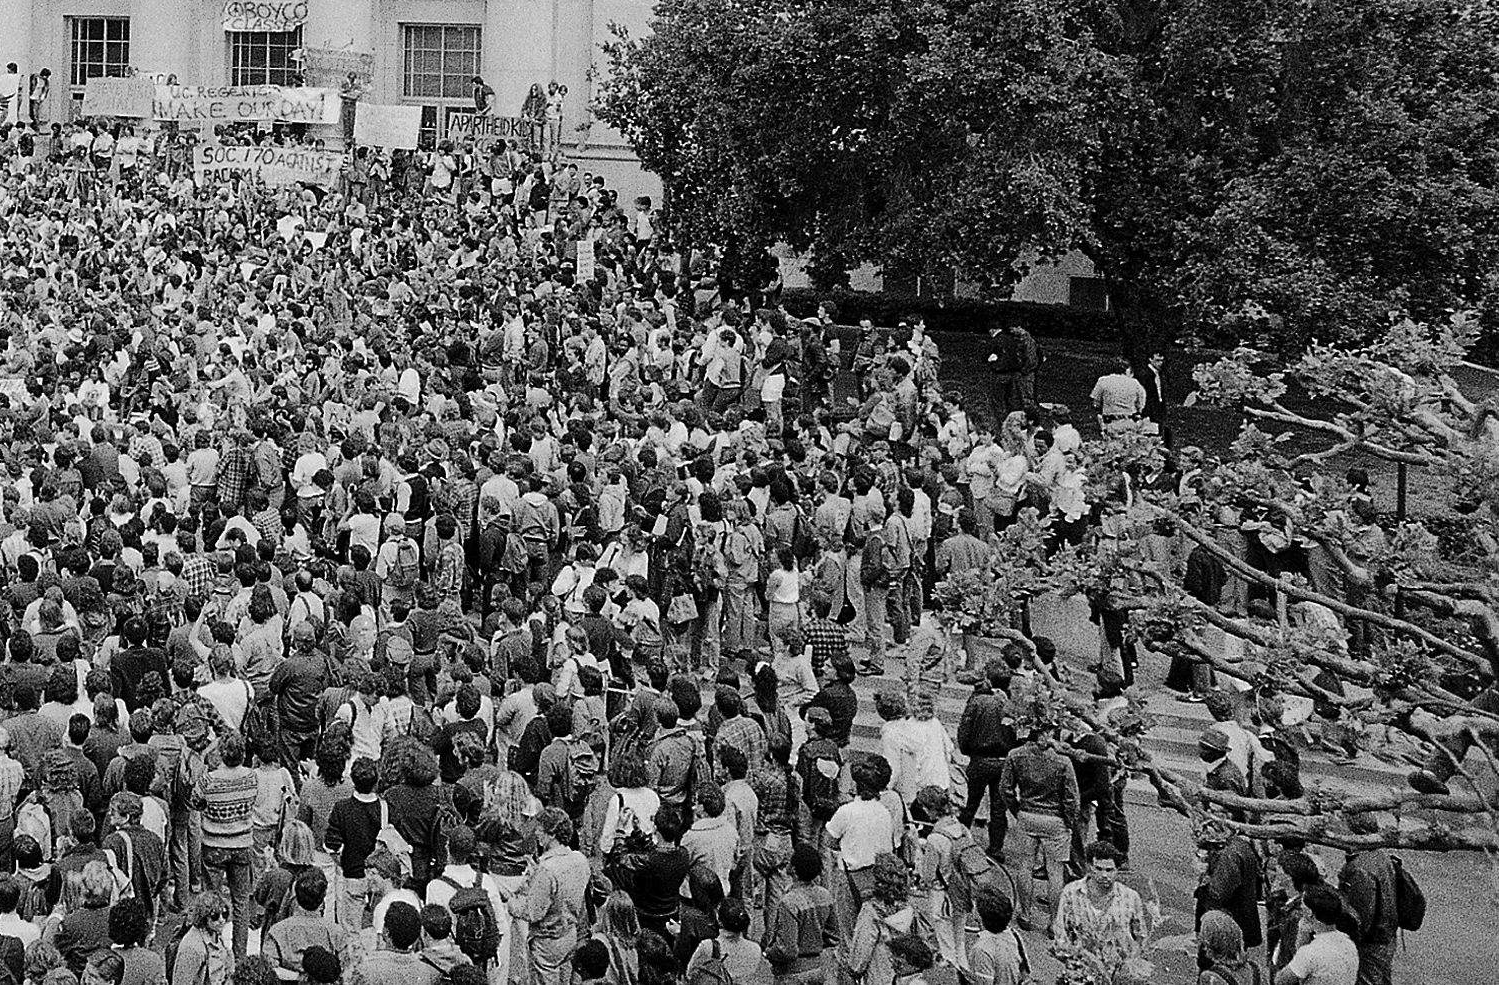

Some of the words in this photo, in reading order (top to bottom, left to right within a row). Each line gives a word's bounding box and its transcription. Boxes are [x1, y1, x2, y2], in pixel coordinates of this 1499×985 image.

[158, 100, 227, 120] MAKE
[237, 100, 279, 119] OUR
[280, 94, 325, 121] DAY!
[450, 114, 510, 136] APARTHEID
[244, 147, 275, 166] 170
